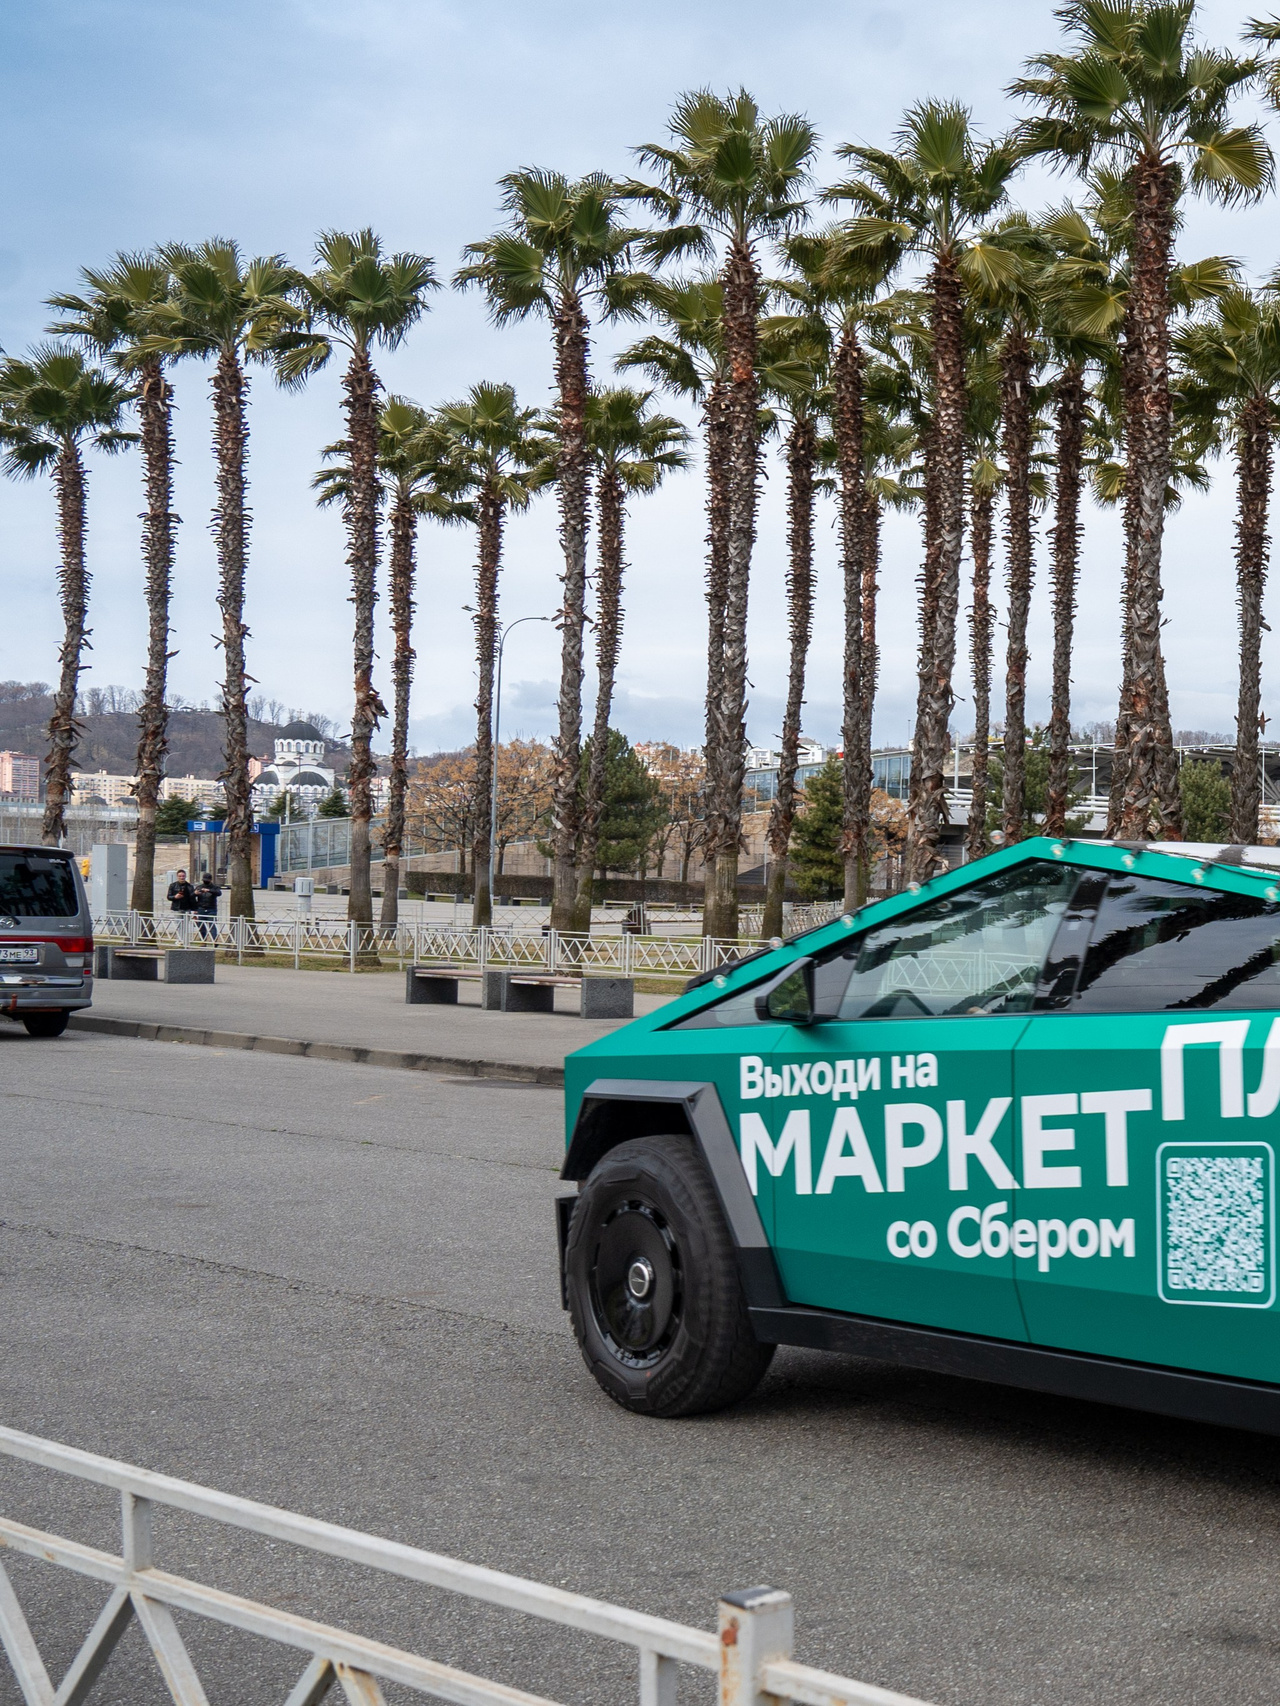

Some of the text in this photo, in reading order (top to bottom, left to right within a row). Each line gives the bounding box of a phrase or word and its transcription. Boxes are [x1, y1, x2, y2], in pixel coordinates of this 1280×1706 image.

[24, 949, 34, 957] 93
[739, 1052, 938, 1101] Выходи на
[886, 1200, 1136, 1273] со Сбером
